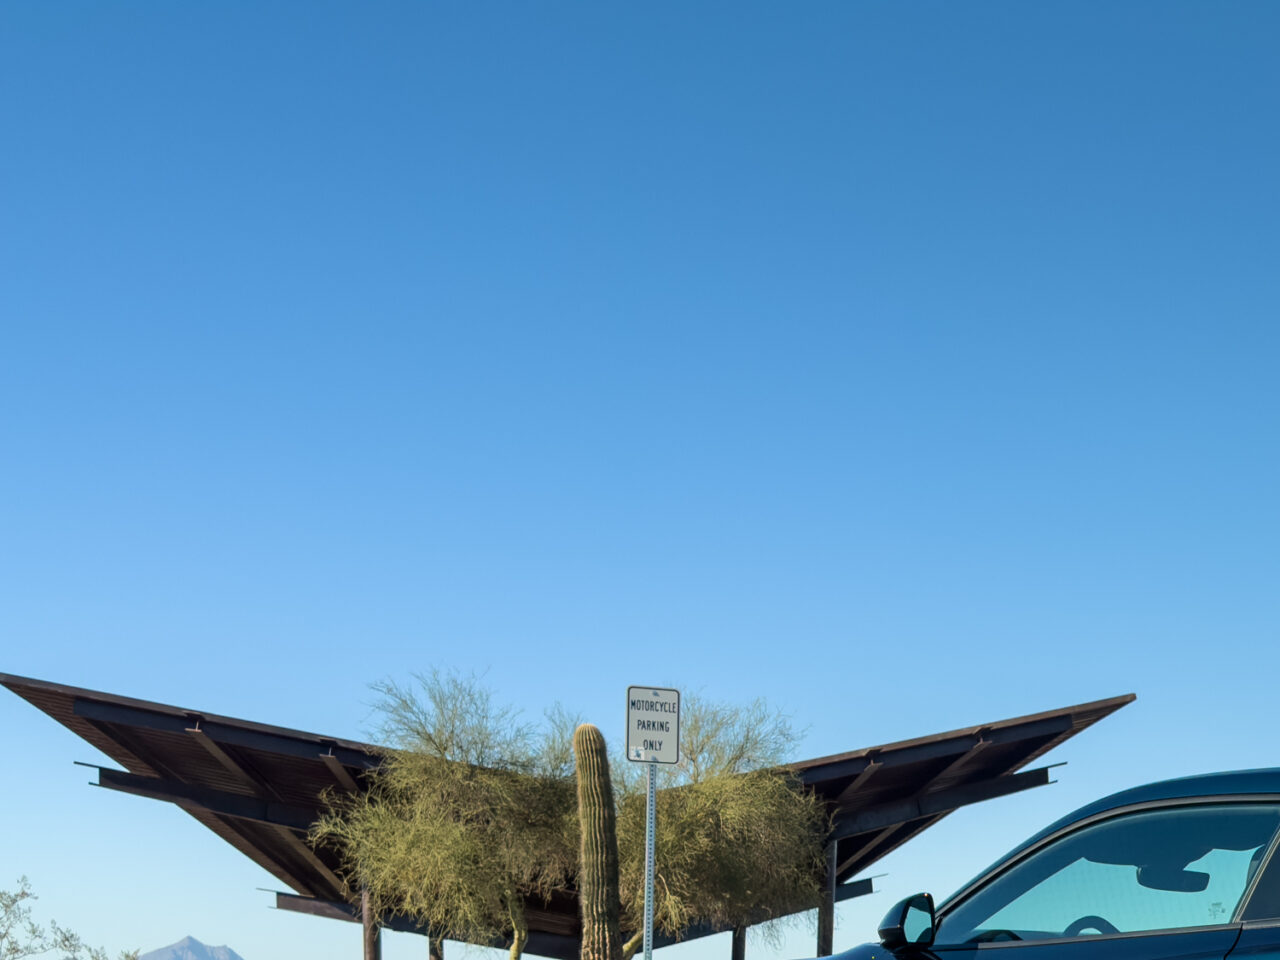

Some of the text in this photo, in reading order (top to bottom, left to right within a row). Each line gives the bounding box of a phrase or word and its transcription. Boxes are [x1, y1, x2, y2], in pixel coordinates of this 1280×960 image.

[630, 699, 677, 714] MOTORCYCLE
[636, 719, 670, 732] PARKING
[643, 739, 663, 751] ONLY
